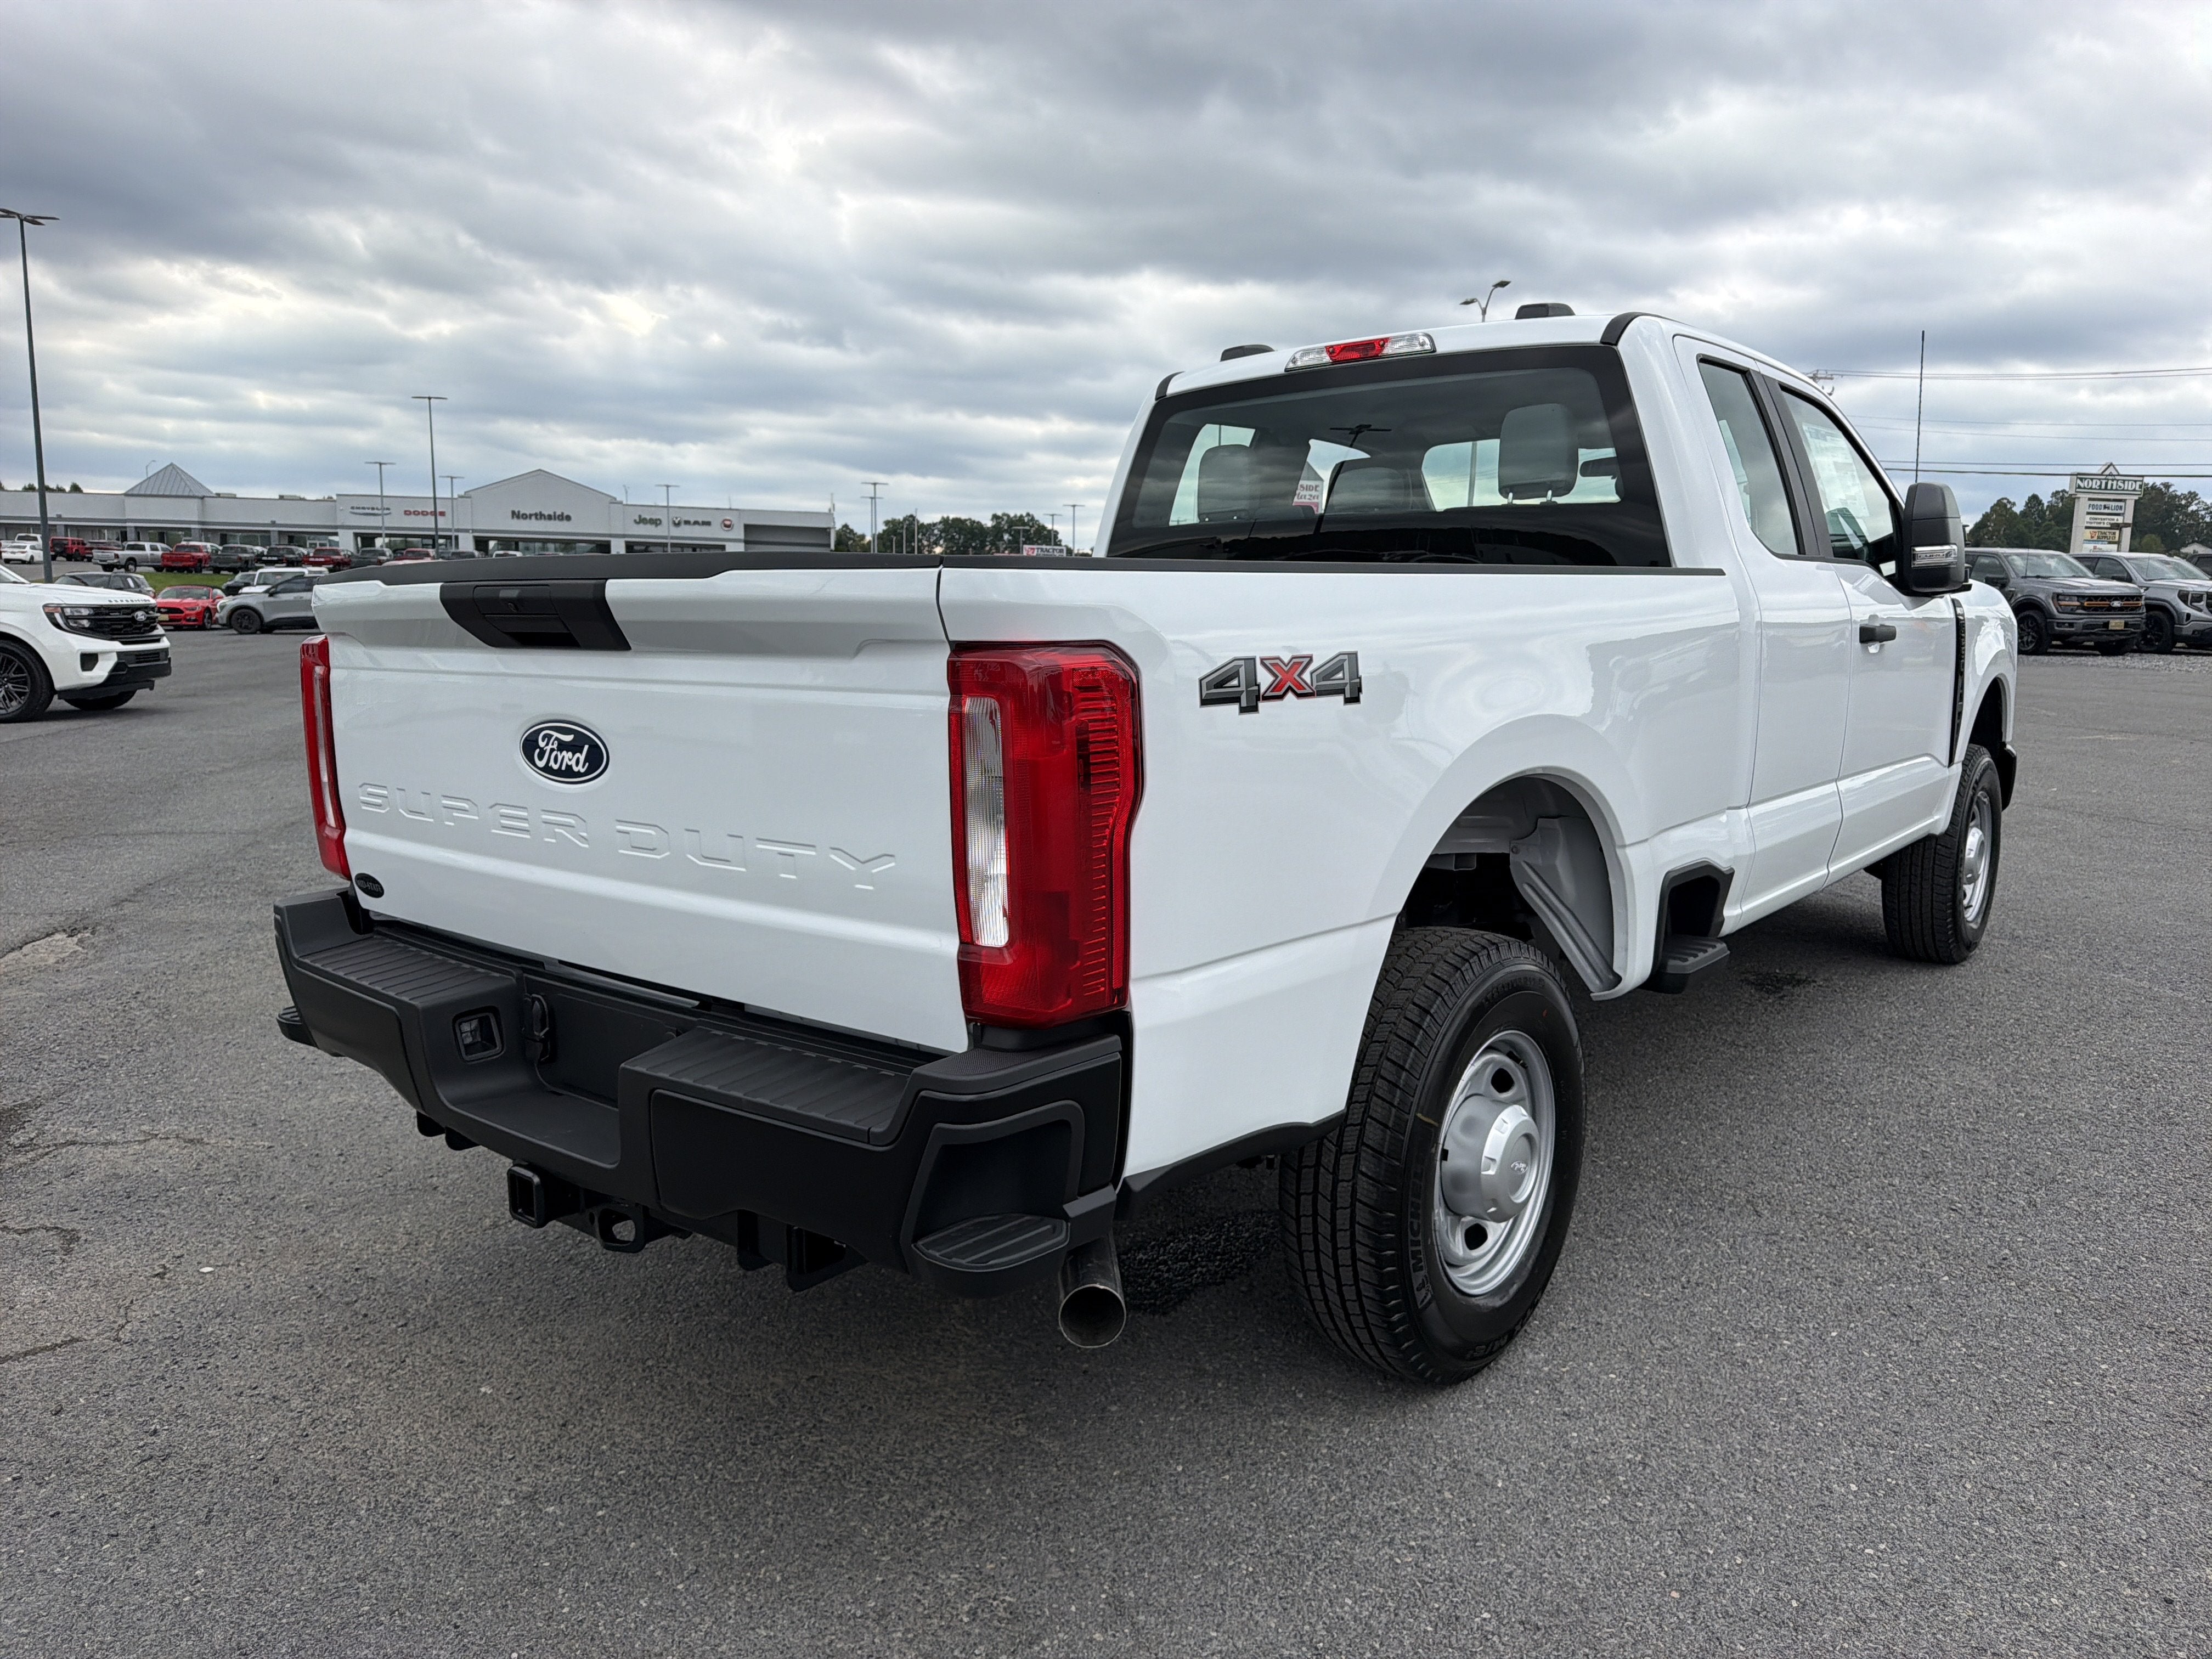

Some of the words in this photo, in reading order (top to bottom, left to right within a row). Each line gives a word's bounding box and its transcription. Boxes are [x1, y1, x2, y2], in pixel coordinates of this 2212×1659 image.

[1297, 492, 1319, 500] laza
[2076, 478, 2142, 490] NORTHSIDE
[511, 510, 572, 522] Northside
[634, 514, 662, 527] Jeep
[534, 730, 589, 773] Ford
[358, 782, 590, 848] SUPER
[615, 819, 896, 890] DUTY
[1408, 1147, 1426, 1273] MICHEL
